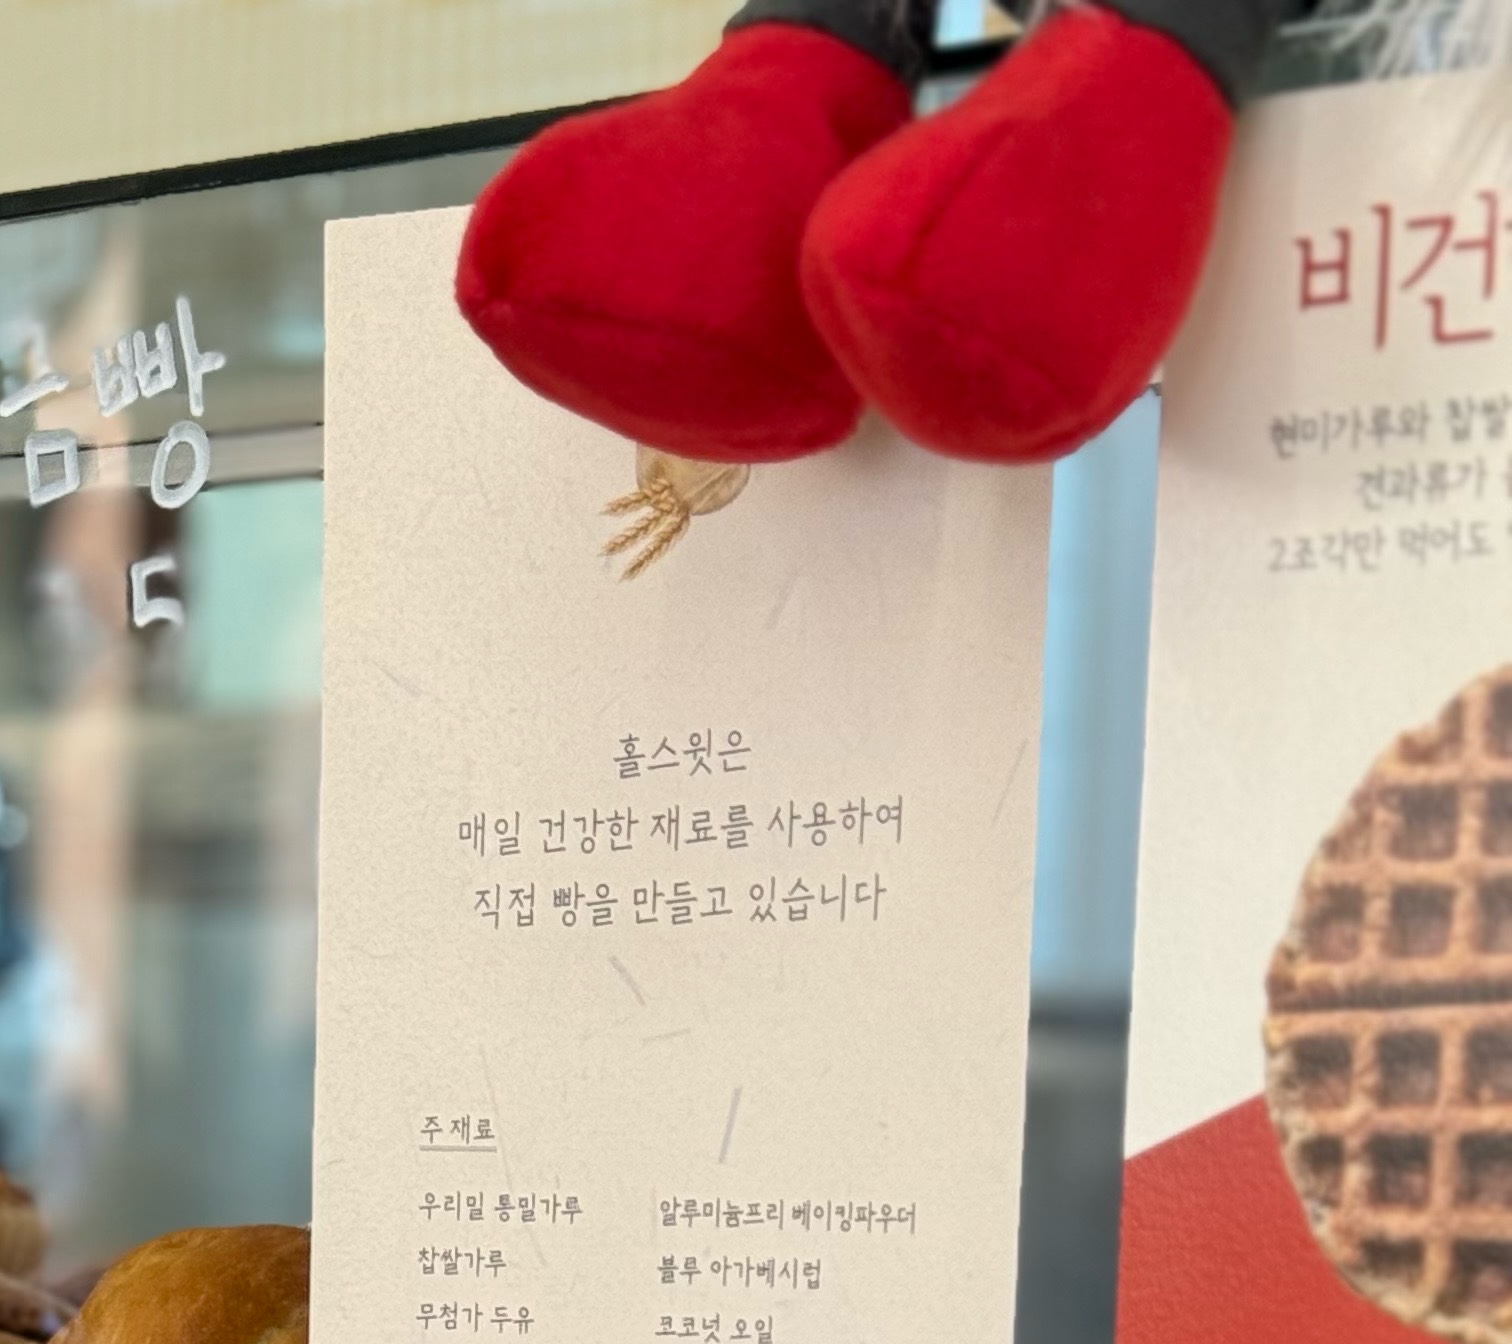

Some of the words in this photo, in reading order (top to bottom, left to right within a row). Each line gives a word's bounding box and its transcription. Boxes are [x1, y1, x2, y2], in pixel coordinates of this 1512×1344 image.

[1293, 188, 1512, 350] 비건
[612, 727, 752, 780] 홀스윗은
[458, 810, 521, 858] 매일
[538, 806, 640, 855] 건강한
[649, 804, 754, 852] 재료를
[767, 794, 903, 849] 사용하여
[473, 881, 535, 931] 직접
[552, 880, 619, 928] 빵을
[633, 879, 734, 926] 만들고
[749, 872, 888, 924] 있습니다
[418, 1190, 485, 1222] 우리밀
[494, 1192, 584, 1225] 통밀가루
[659, 1196, 784, 1231] 알루미늄프리
[791, 1199, 916, 1235] 베이킹파우더
[417, 1246, 507, 1278] 찹쌀가루
[656, 1254, 703, 1285] 블루
[709, 1255, 821, 1291] 아가베시럽
[415, 1301, 484, 1333] 무첨가
[489, 1305, 535, 1335] 두유
[654, 1312, 721, 1344] 코코넛
